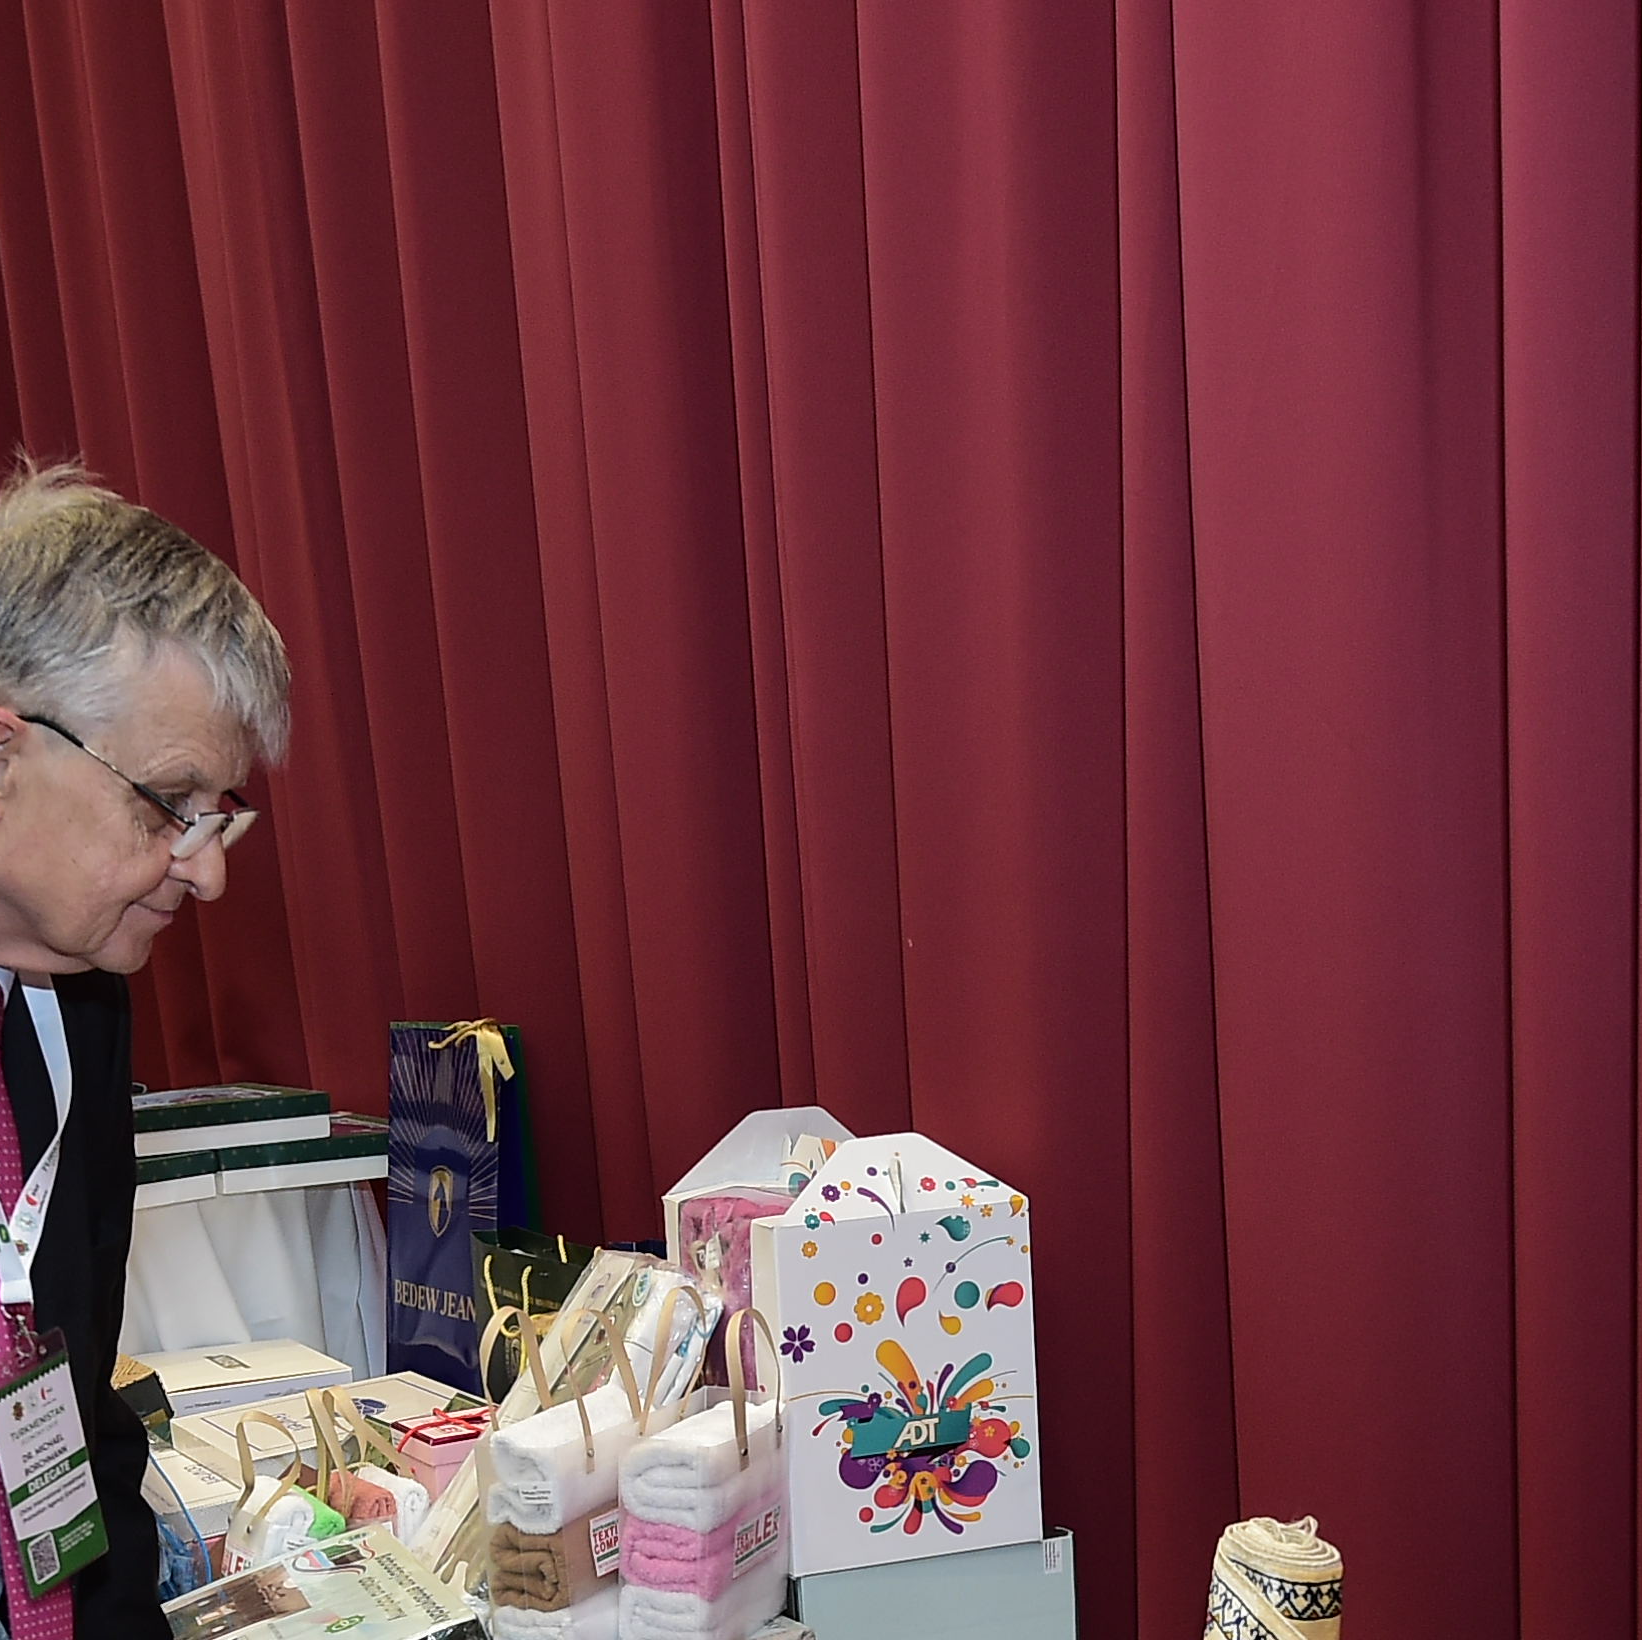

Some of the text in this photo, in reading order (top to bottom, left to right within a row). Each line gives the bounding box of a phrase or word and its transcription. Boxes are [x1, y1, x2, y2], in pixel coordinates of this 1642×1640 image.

[394, 1279, 440, 1314] BEDEW
[893, 1416, 940, 1448] ADT
[27, 1460, 71, 1494] DELEGATE
